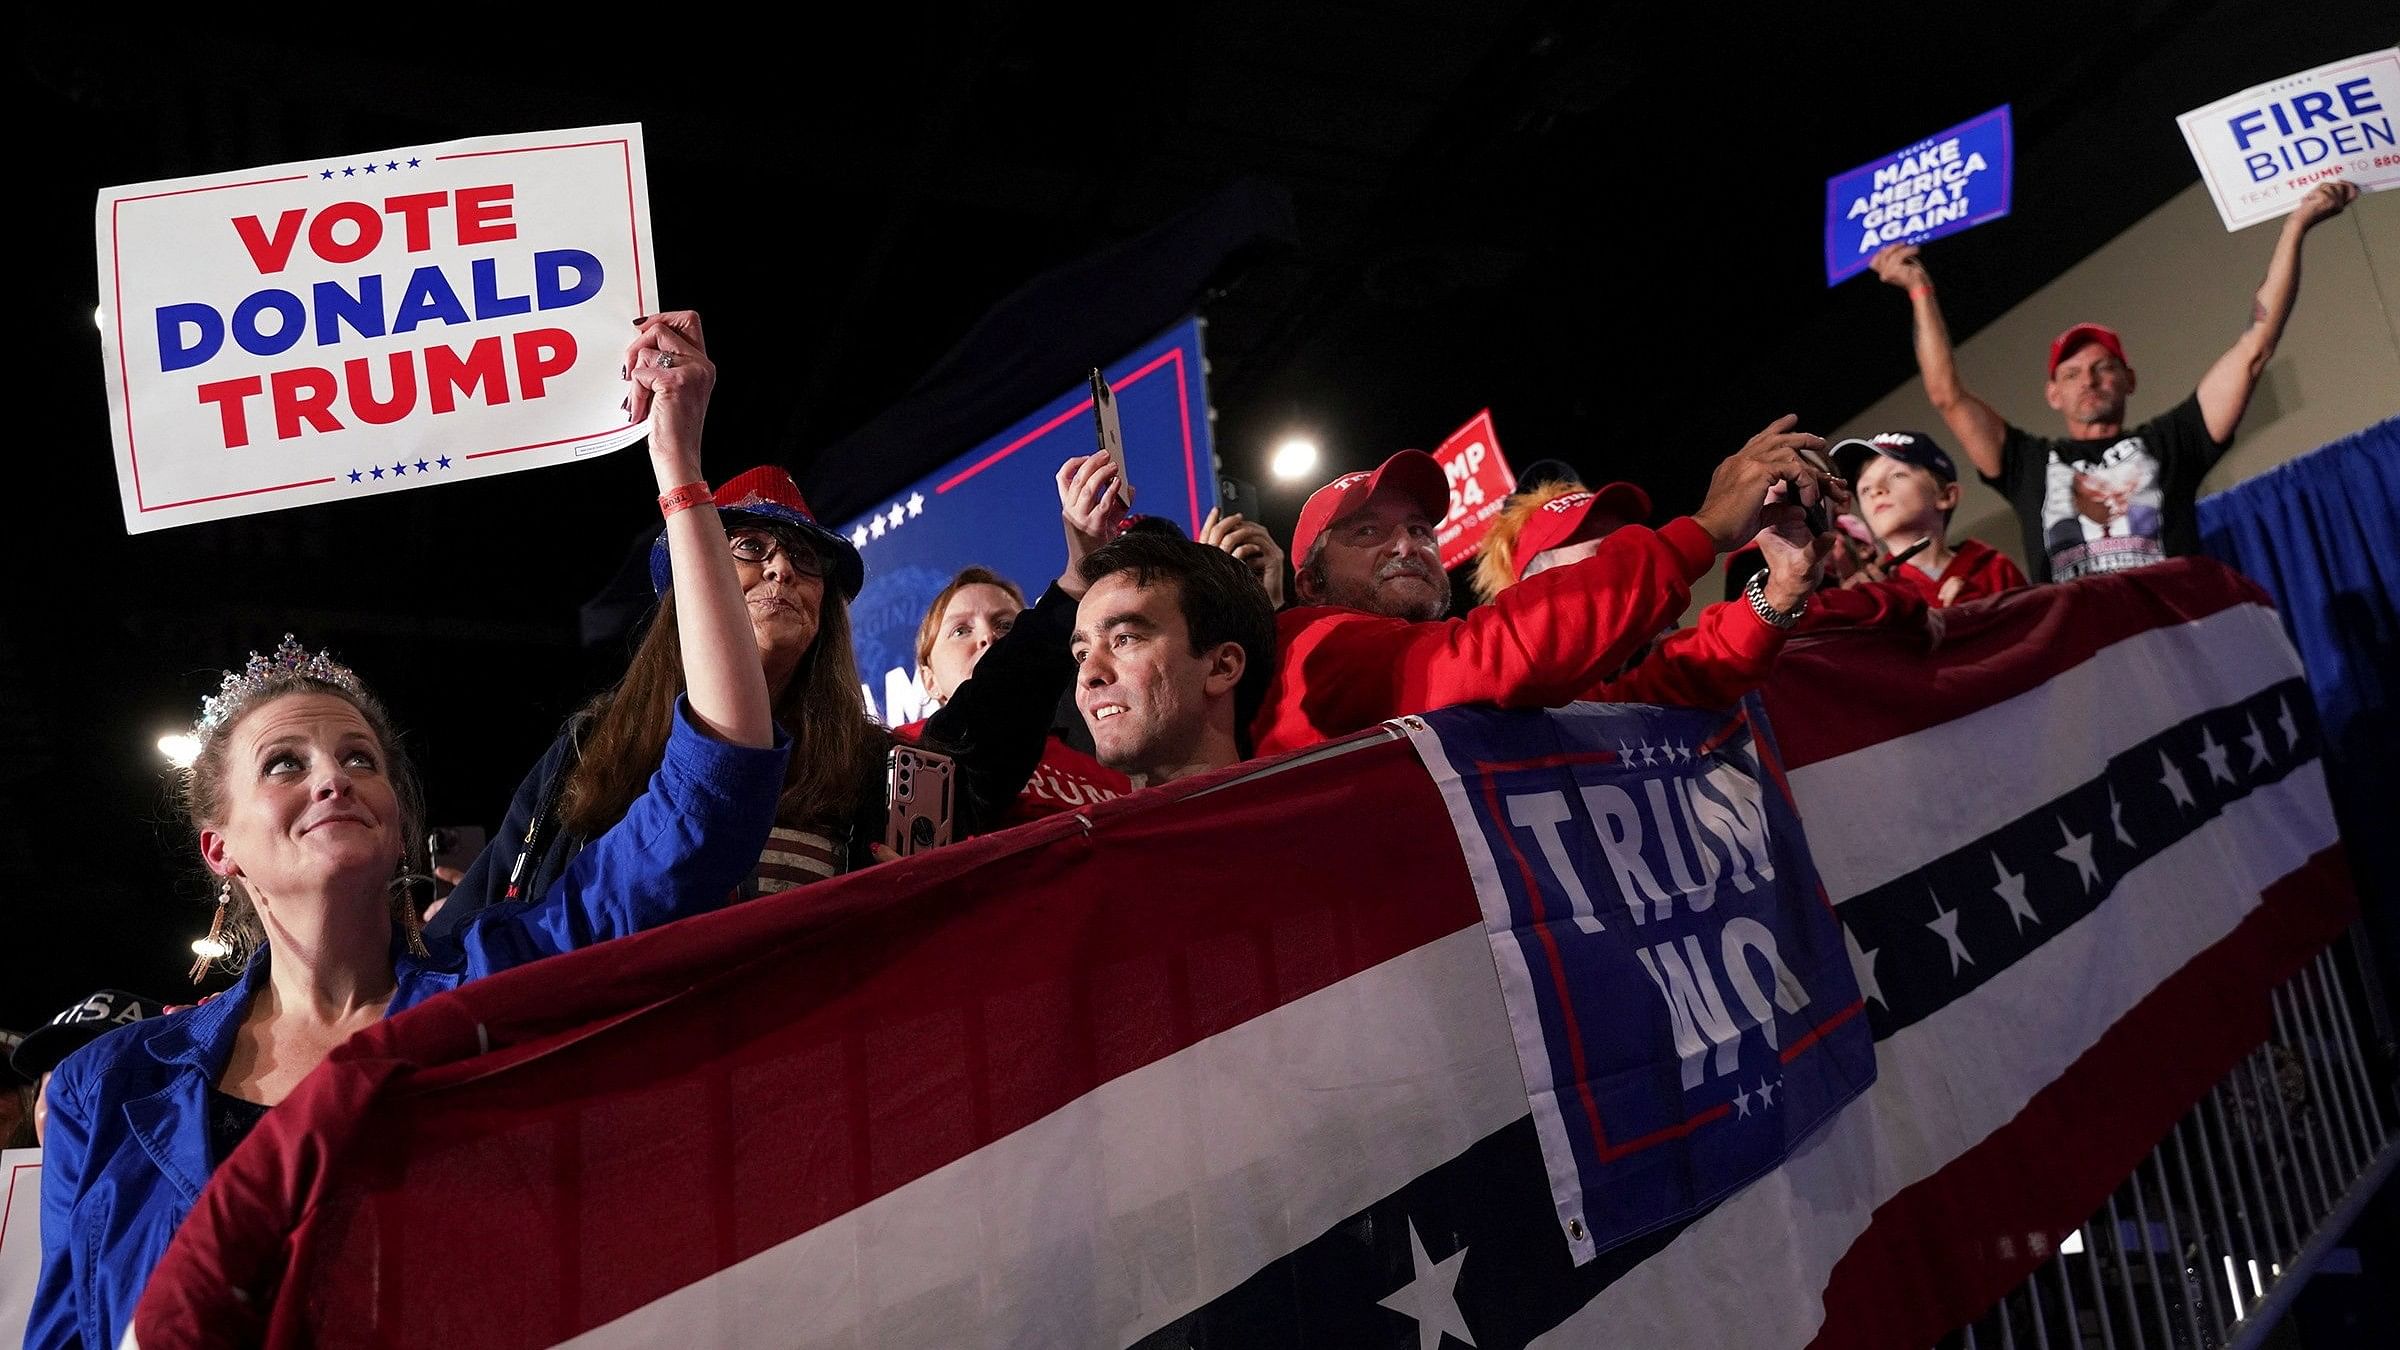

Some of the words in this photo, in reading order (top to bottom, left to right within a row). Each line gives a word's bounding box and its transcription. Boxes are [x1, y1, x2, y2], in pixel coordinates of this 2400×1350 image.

[2228, 77, 2383, 150] FIRE
[1873, 137, 1960, 191] MAKE
[2241, 185, 2281, 205] TEXT
[2287, 164, 2345, 190] TRUMP
[2350, 158, 2369, 172] TO
[2373, 155, 2400, 169] 880
[2244, 117, 2396, 182] BIDEN
[1846, 151, 1988, 220] AMERICA
[1862, 177, 1969, 230] GREAT
[230, 183, 517, 275] VOTE
[1858, 196, 1970, 254] AGAIN!
[155, 248, 605, 372] DONALD
[196, 327, 578, 449] TRUMP
[1506, 762, 1776, 935] TRUM
